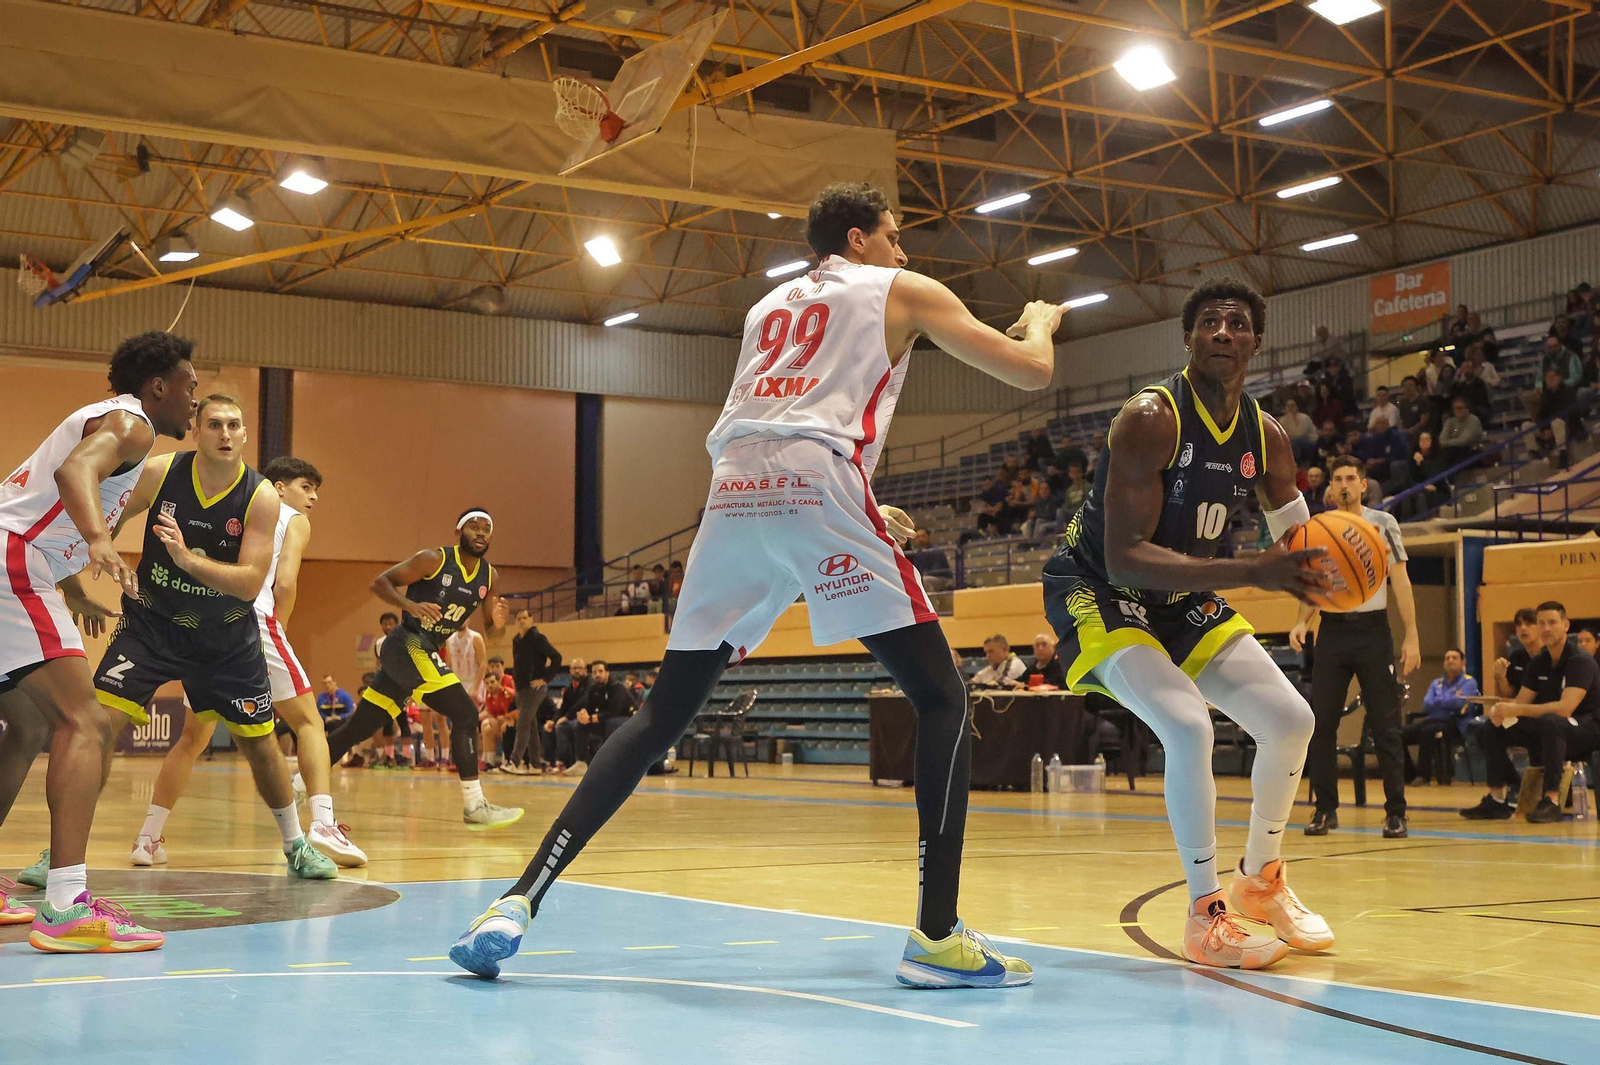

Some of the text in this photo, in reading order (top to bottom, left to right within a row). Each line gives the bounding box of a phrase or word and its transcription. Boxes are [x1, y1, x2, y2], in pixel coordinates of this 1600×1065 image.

[1395, 272, 1424, 291] Bar
[754, 302, 830, 375] 99
[709, 502, 754, 511] MANUFACTURAS
[1196, 502, 1227, 540] 10
[1341, 524, 1376, 589] Wilson
[814, 572, 874, 594] HYUNDAI
[825, 584, 870, 601] Lemauto
[444, 603, 466, 622] 20
[106, 653, 135, 681] 2
